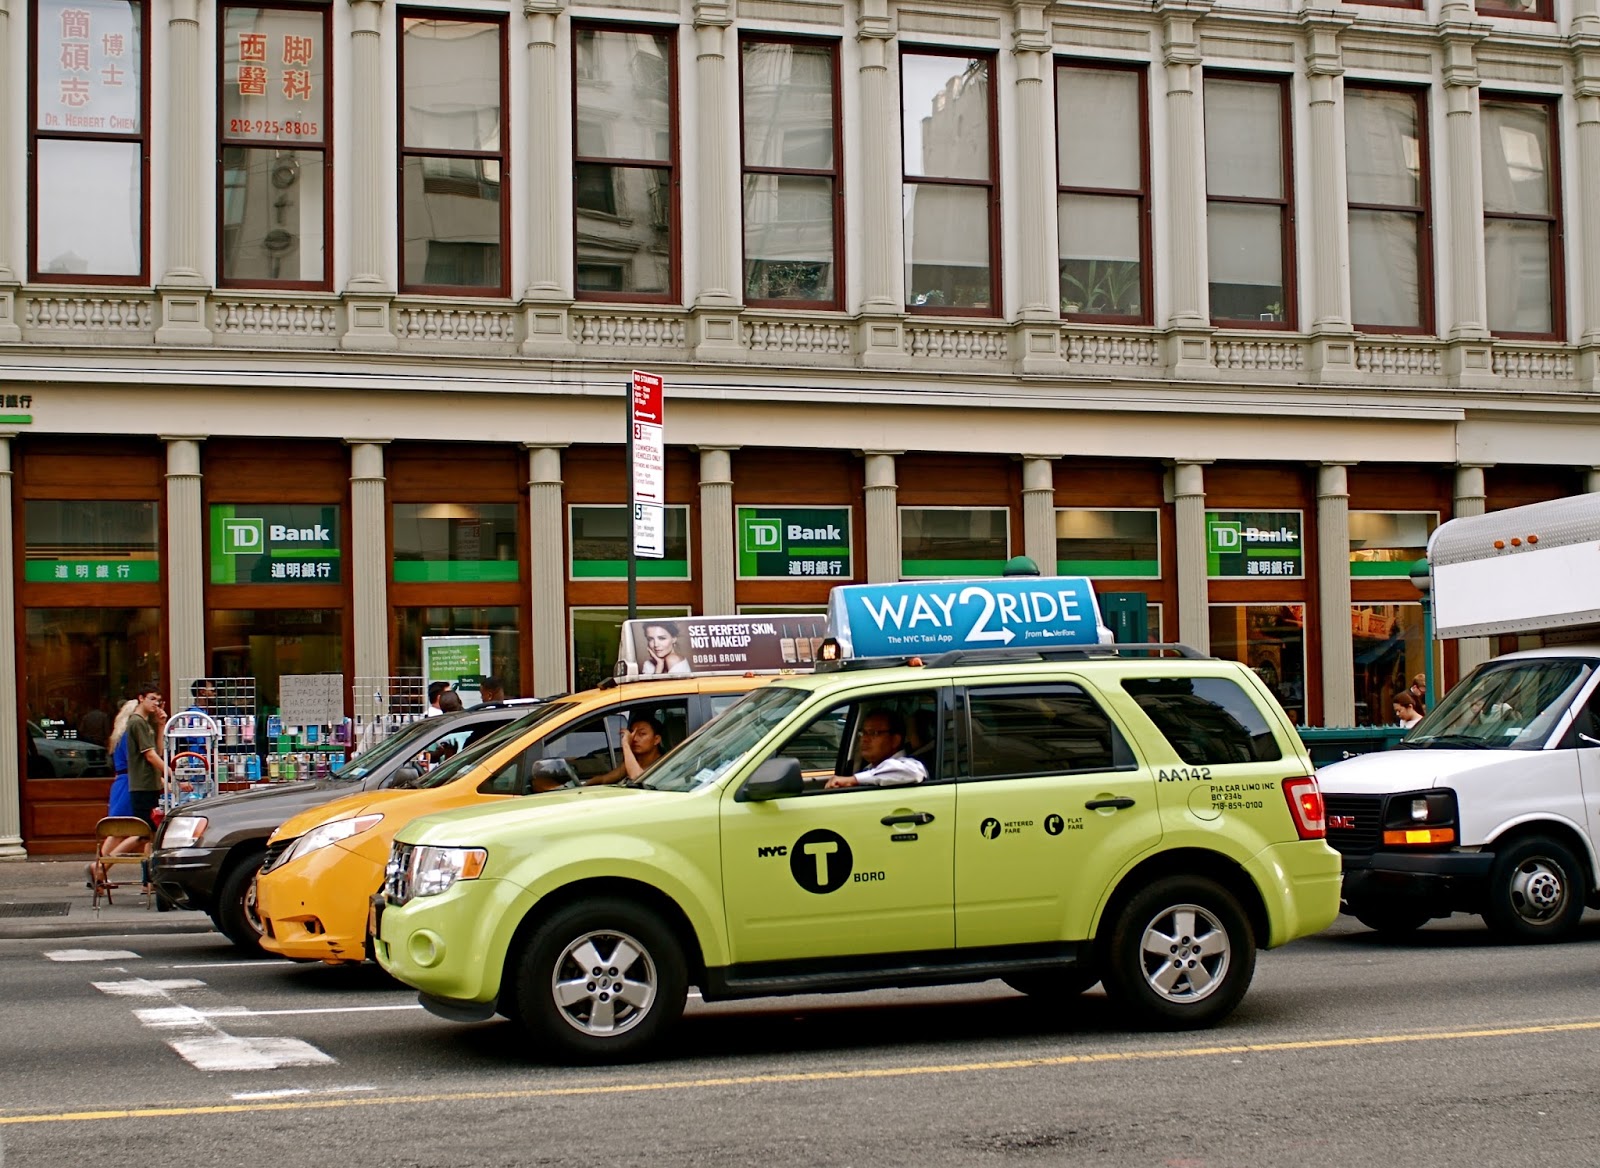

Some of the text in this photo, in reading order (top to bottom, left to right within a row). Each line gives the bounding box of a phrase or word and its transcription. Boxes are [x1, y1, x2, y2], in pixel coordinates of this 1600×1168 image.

[101, 33, 124, 86] 博士
[239, 33, 267, 95] 西醫
[230, 119, 318, 135] 212-925-8805
[227, 525, 330, 547] TD Bank
[749, 525, 841, 545] TD Bank
[1213, 527, 1294, 546] TD Bank
[271, 562, 331, 578] 道明銀行
[788, 560, 842, 575] 道明銀行
[1247, 561, 1294, 575] 道明銀行
[688, 623, 777, 636] SEE PERFECT SKIN,
[1025, 630, 1042, 639] from
[690, 635, 751, 648] NOT MAKEUP
[903, 635, 920, 643] NYC
[921, 634, 936, 642] Taxi
[937, 634, 953, 643] App
[693, 653, 747, 663] BOBBI BROWN
[1158, 767, 1212, 782] AA142
[1225, 784, 1240, 792] CAR
[1242, 783, 1260, 791] LIMO
[1262, 782, 1275, 790] INC
[1212, 801, 1263, 810] 718-859-0100
[1328, 815, 1355, 828] GMC
[758, 846, 787, 857] NYC
[854, 871, 885, 882] BORO
